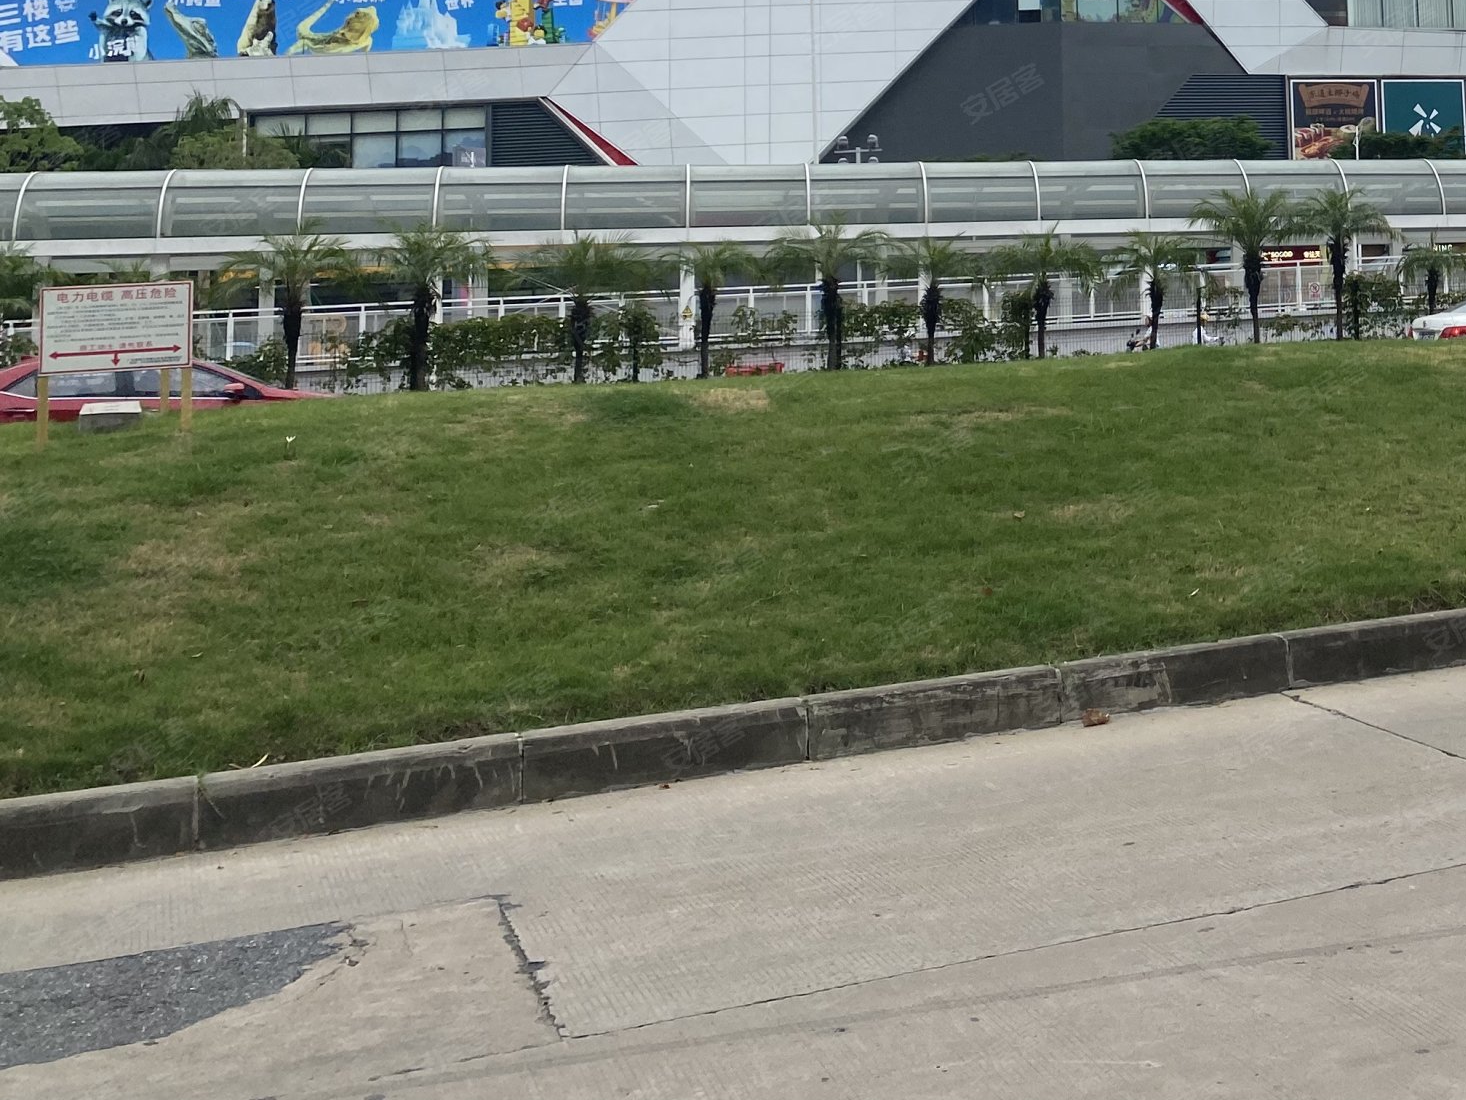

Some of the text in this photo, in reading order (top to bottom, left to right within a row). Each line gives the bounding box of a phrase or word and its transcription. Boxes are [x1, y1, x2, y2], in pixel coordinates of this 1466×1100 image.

[57, 287, 178, 303] 电力电缆 高压危险
